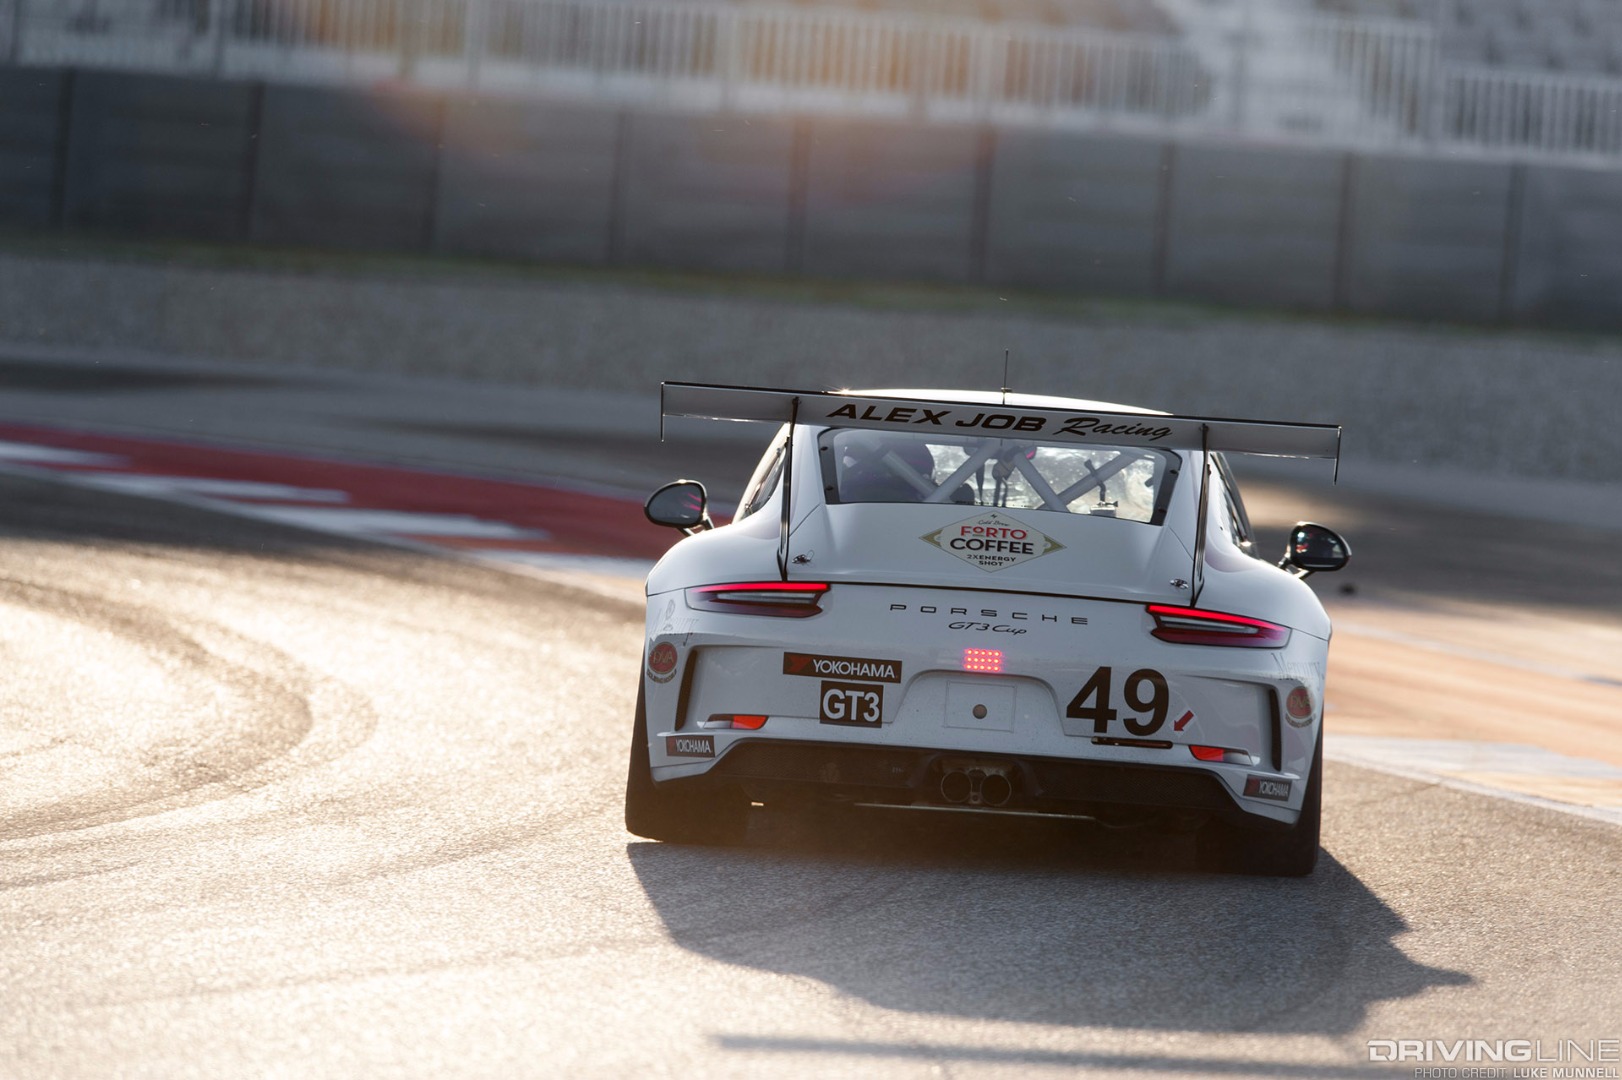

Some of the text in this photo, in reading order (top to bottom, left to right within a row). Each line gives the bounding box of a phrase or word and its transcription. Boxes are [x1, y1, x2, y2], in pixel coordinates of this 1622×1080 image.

[825, 403, 1174, 441] ALEX JOB Racing
[950, 538, 1034, 555] COFFEE
[889, 604, 1088, 625] PORSCHE
[948, 621, 1028, 635] GT3 Cup
[813, 659, 895, 678] YOKOHAMA
[822, 688, 880, 722] GT3
[1066, 666, 1169, 736] 49
[675, 738, 711, 753] YOKOHAMA
